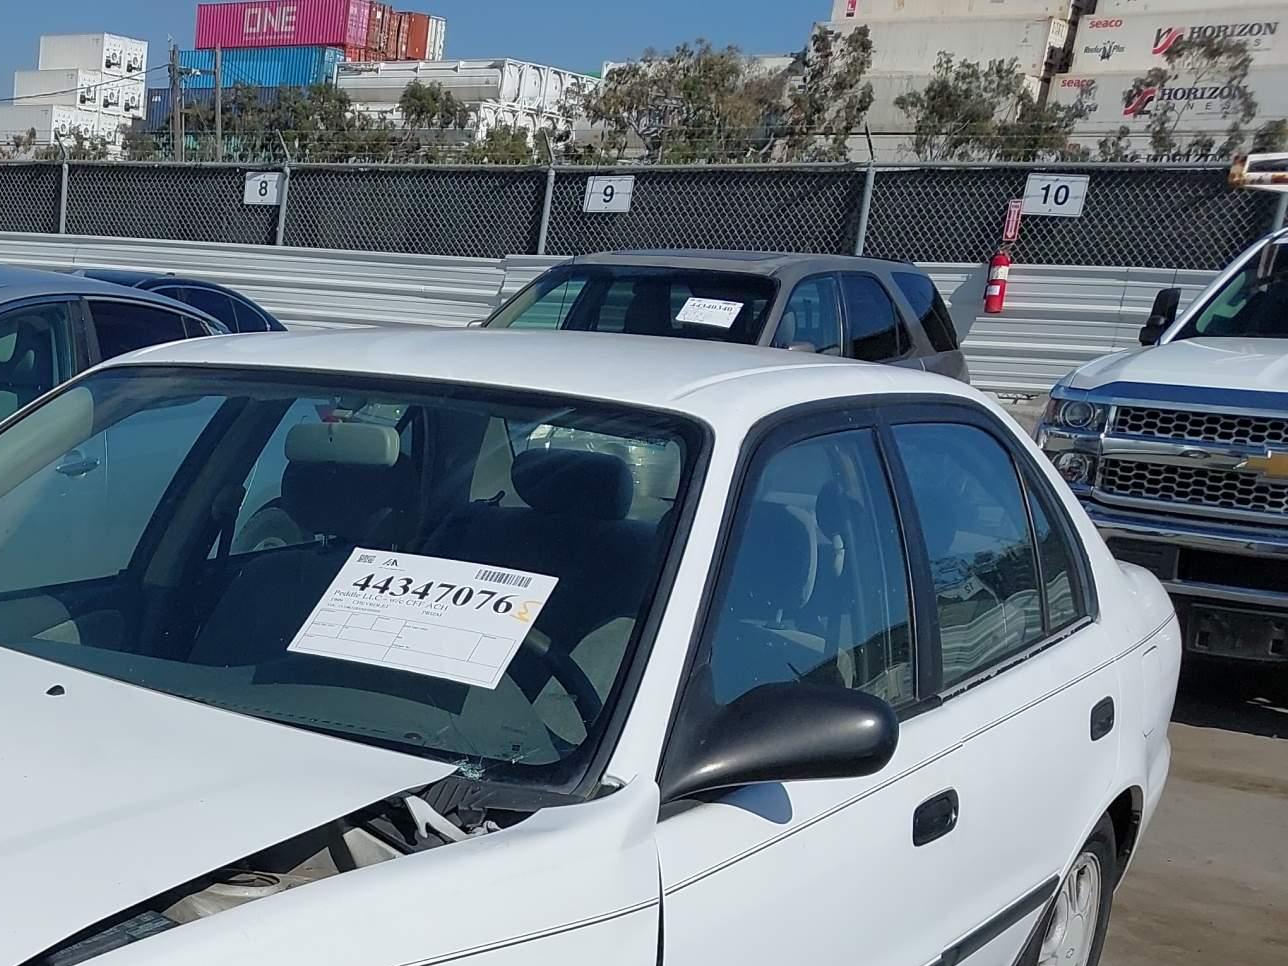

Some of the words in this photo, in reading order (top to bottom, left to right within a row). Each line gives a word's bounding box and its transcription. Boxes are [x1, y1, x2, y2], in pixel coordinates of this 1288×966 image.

[244, 6, 296, 33] ONE
[1089, 17, 1123, 29] seaco
[1188, 22, 1279, 41] HORIZON
[1061, 79, 1096, 88] seaco
[259, 180, 268, 197] 8
[603, 185, 615, 204] 9
[1040, 184, 1070, 206] 10
[334, 589, 361, 599] Peddle
[362, 592, 382, 602] LLC
[425, 602, 449, 611] ACH
[352, 573, 520, 614] 44347076
[352, 599, 389, 609] CHEVROLET
